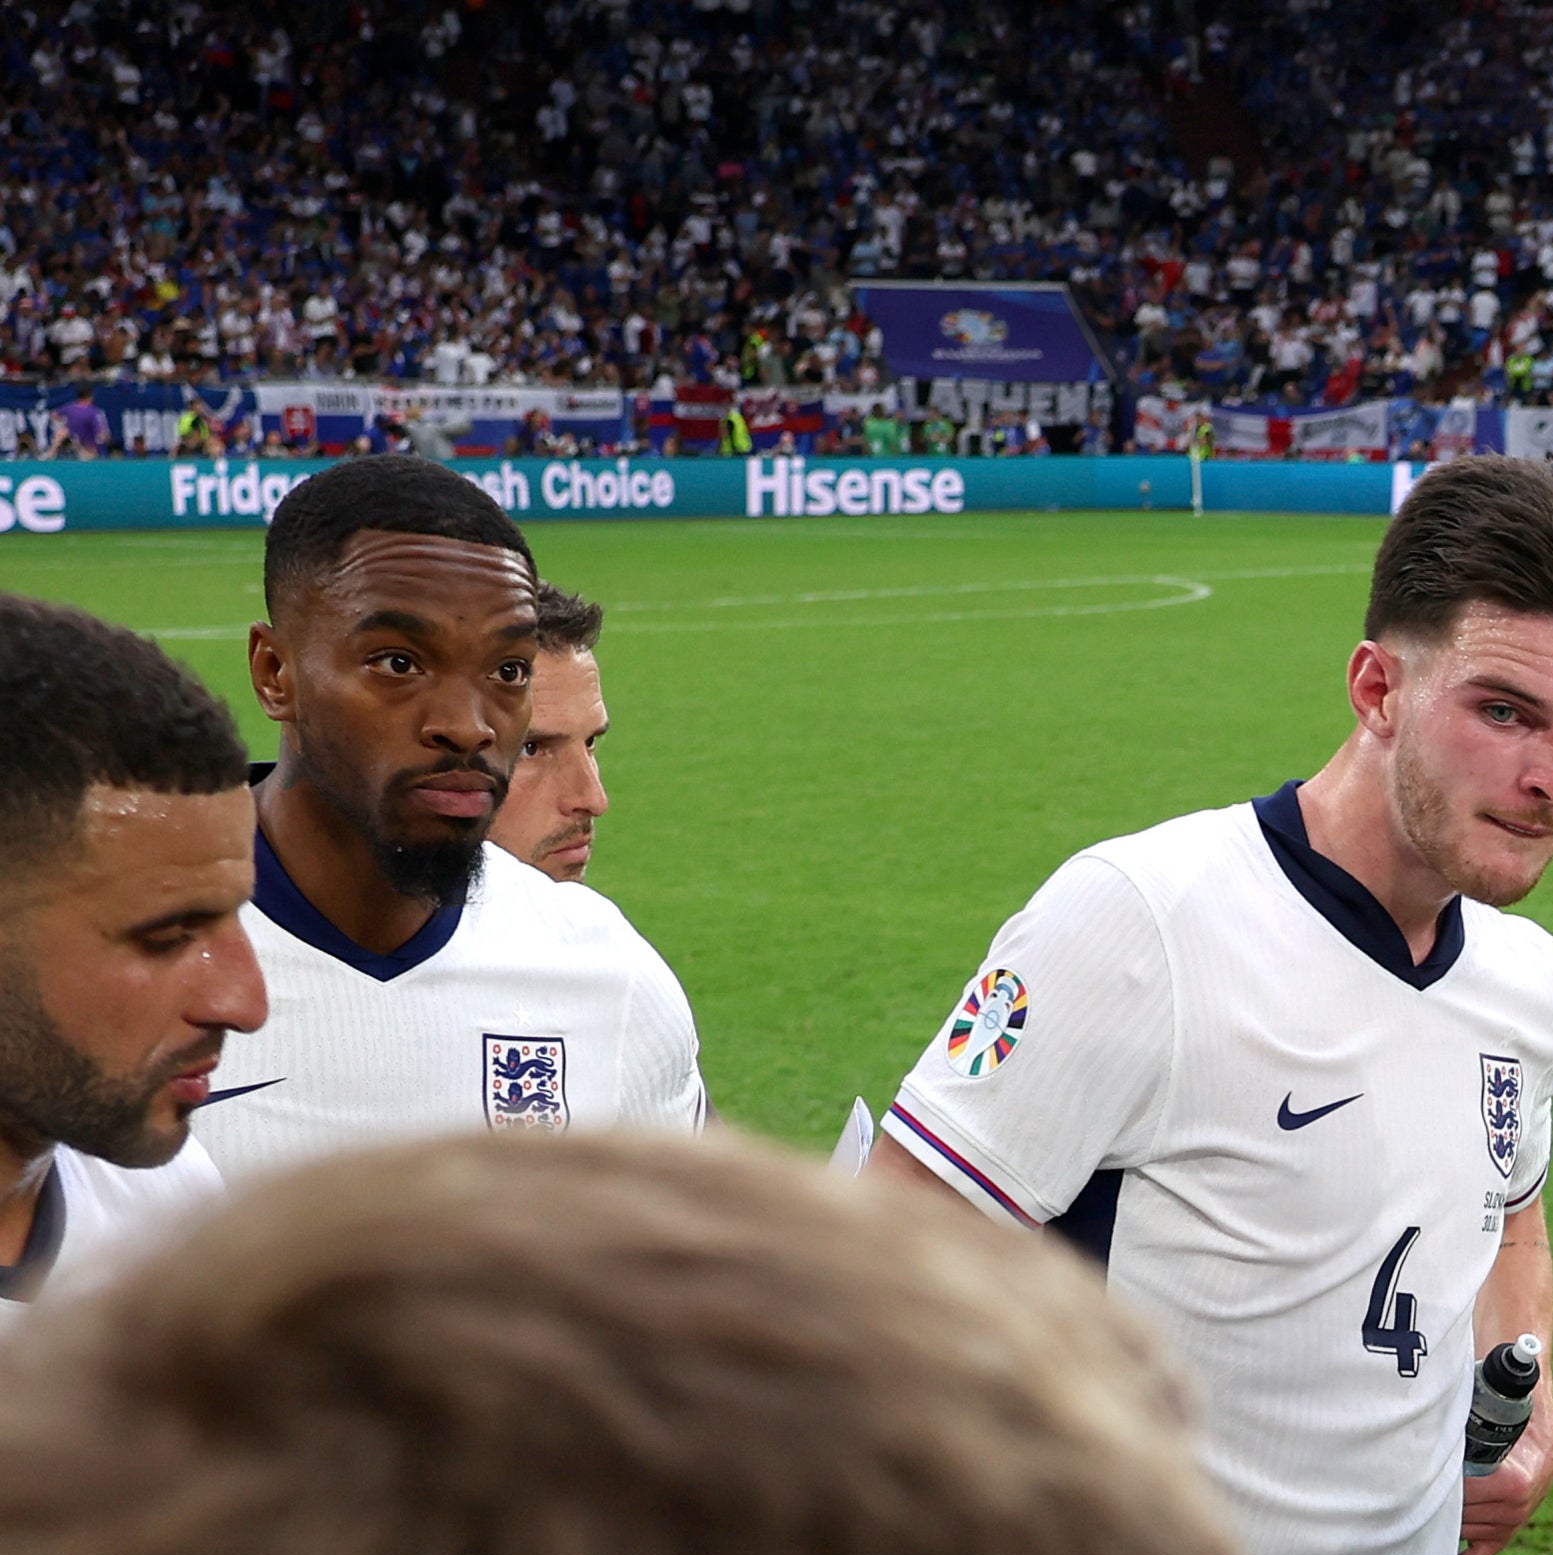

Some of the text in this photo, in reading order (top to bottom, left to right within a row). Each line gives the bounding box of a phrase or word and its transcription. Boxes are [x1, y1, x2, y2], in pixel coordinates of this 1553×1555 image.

[170, 457, 312, 525] Fridg
[541, 457, 675, 510] Choice
[745, 456, 965, 518] Hisense
[1361, 1226, 1428, 1378] 4
